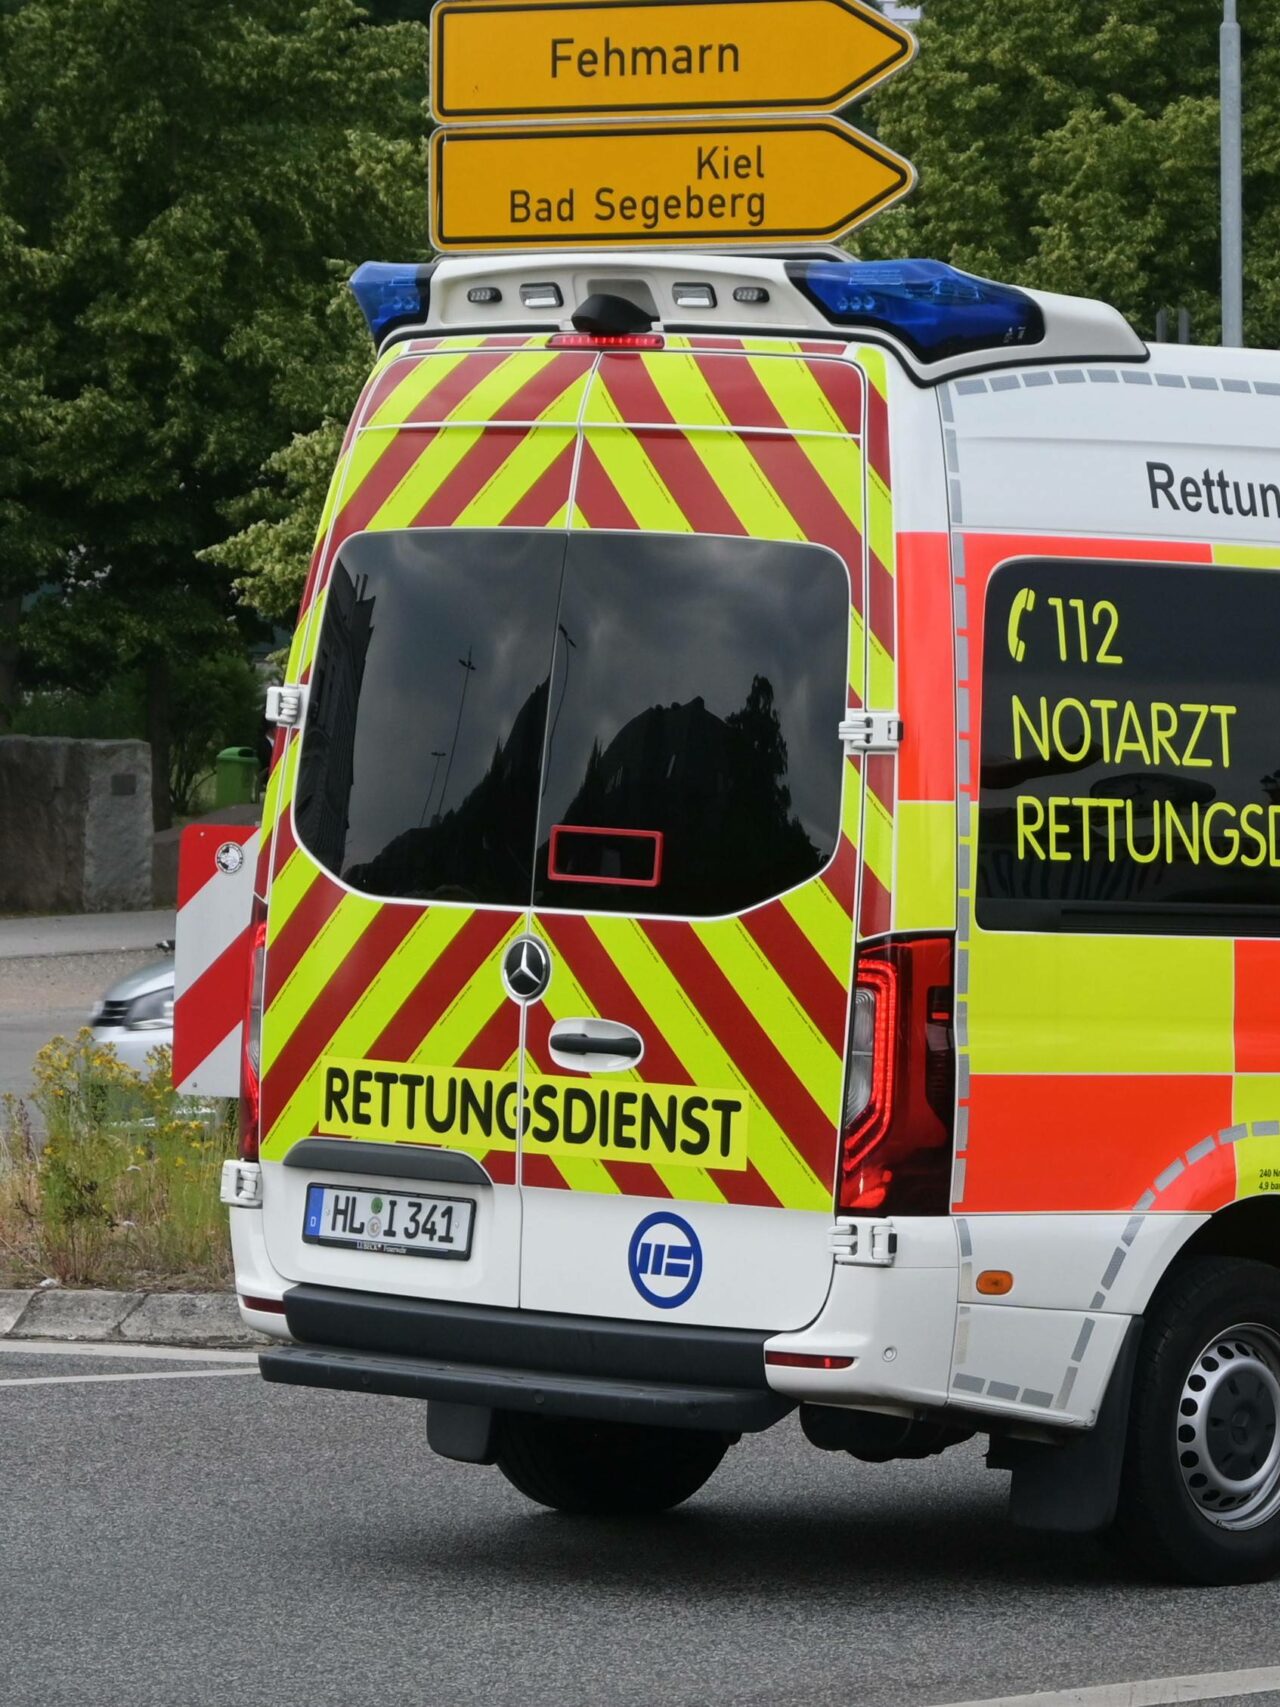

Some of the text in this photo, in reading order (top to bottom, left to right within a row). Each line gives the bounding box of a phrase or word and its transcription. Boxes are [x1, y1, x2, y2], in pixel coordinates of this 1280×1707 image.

[550, 37, 740, 79] Fehmarn
[697, 145, 765, 180] Kiel
[509, 186, 766, 229] Bad Segeberg
[1048, 597, 1124, 664] 112
[1012, 695, 1237, 768] NOTARZT
[324, 1066, 742, 1157] RETTUNGSDIENST
[1259, 1169, 1272, 1178] 240
[331, 1195, 364, 1234] HL
[383, 1200, 397, 1237] I
[403, 1201, 454, 1243] 341
